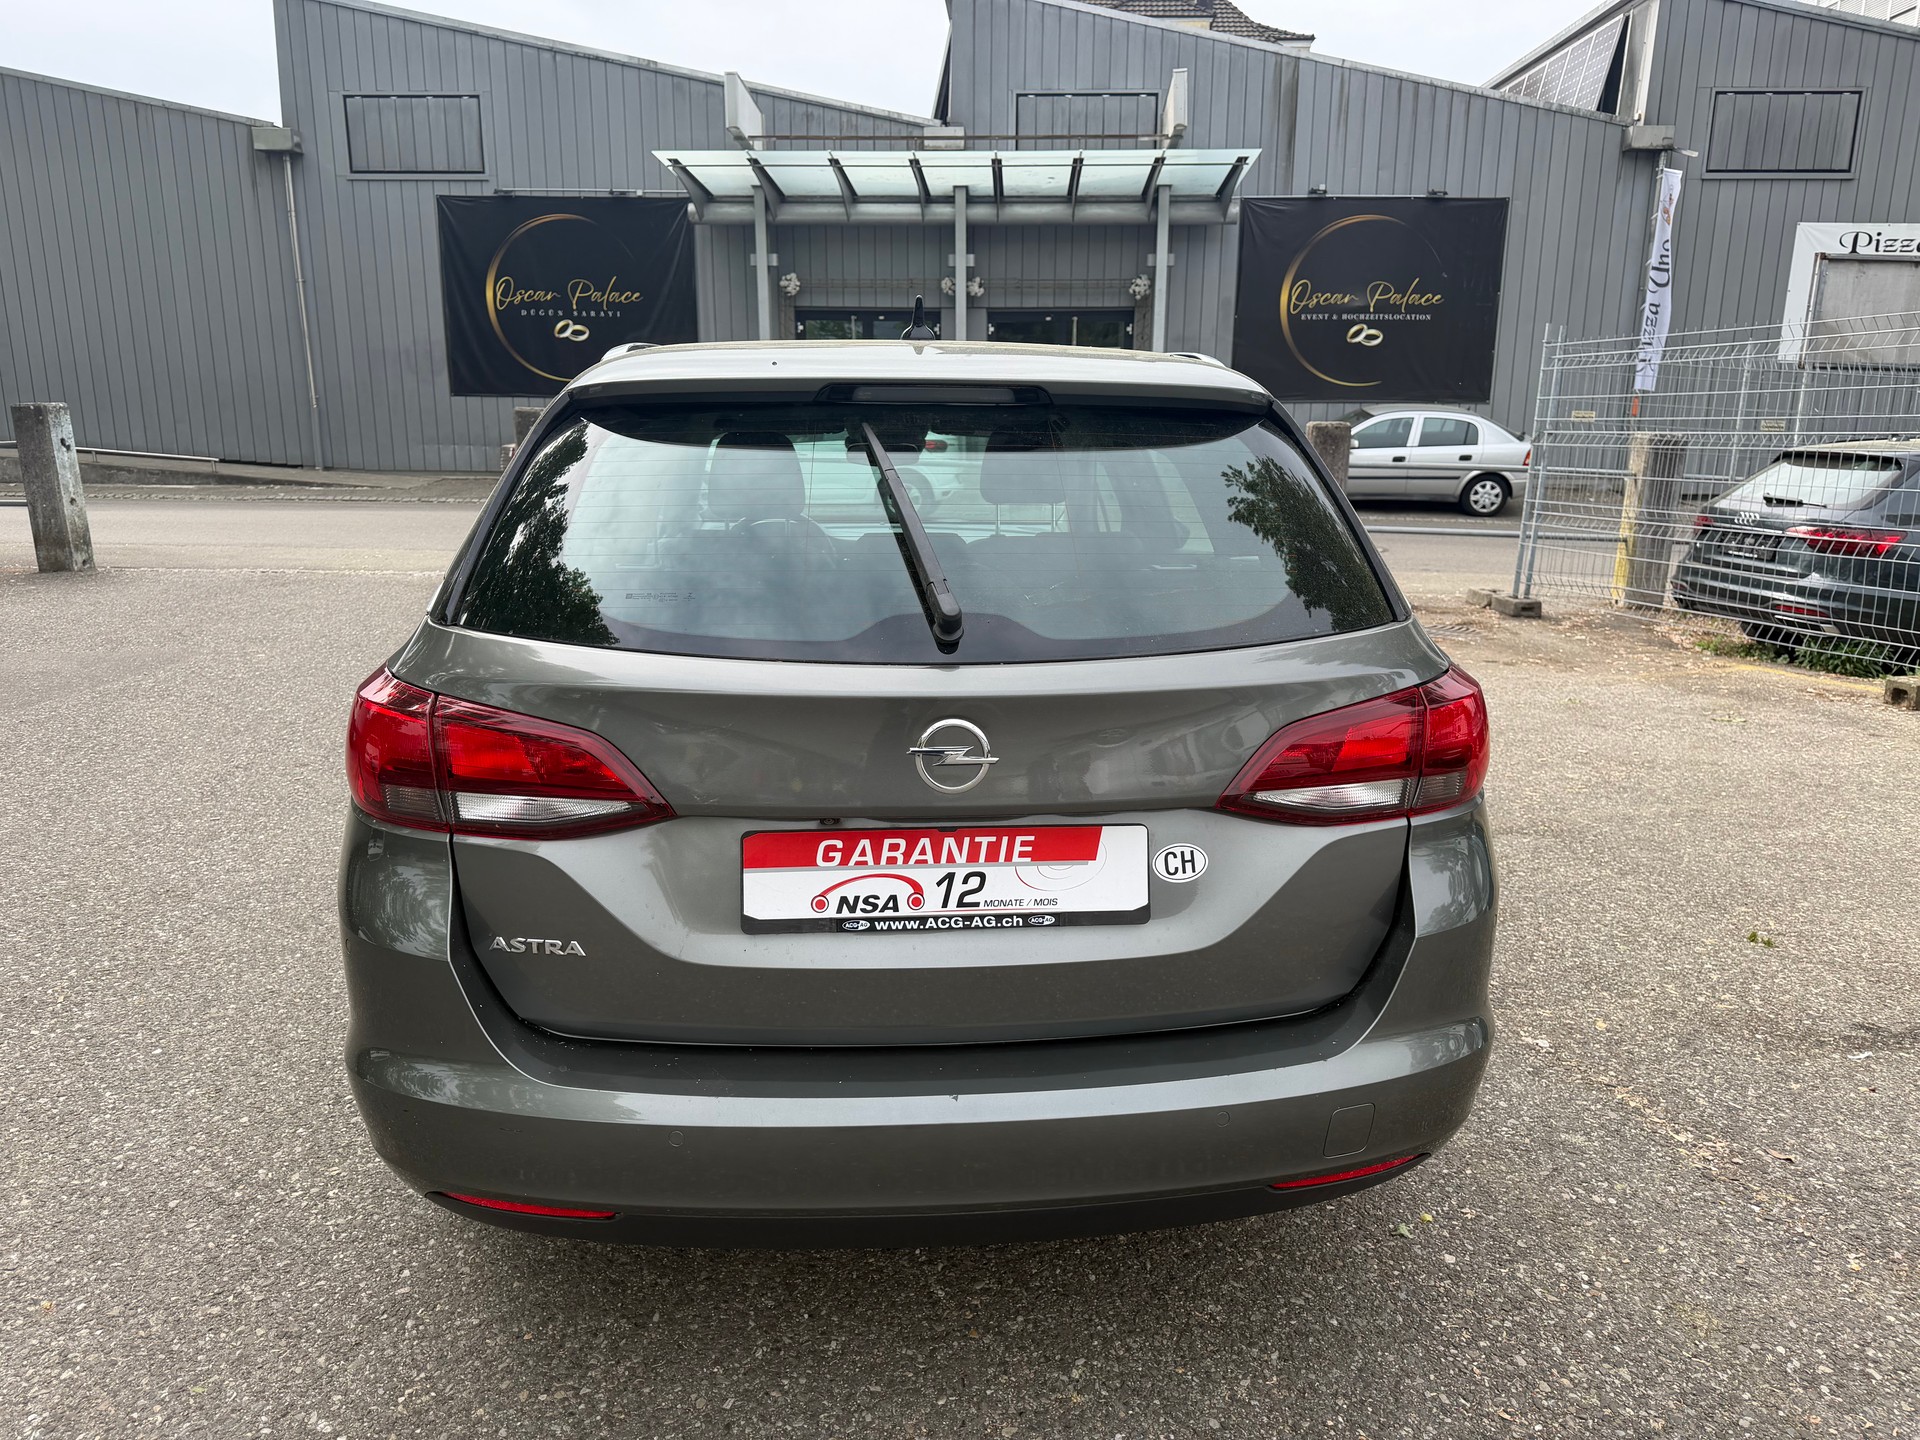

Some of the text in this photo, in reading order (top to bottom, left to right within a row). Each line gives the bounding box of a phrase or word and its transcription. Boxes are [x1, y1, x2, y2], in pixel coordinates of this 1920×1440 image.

[496, 276, 644, 310] Oscar Palace
[1290, 277, 1445, 314] Oscar Palace
[816, 836, 1035, 867] GARANTIE
[1164, 849, 1196, 876] CH
[835, 894, 900, 914] NSA
[935, 871, 987, 909] 12
[983, 899, 1025, 908] MONATE
[1033, 898, 1058, 907] MOIS
[875, 915, 1023, 930] www.ACG-AG.ch
[489, 936, 587, 956] ASTRA
